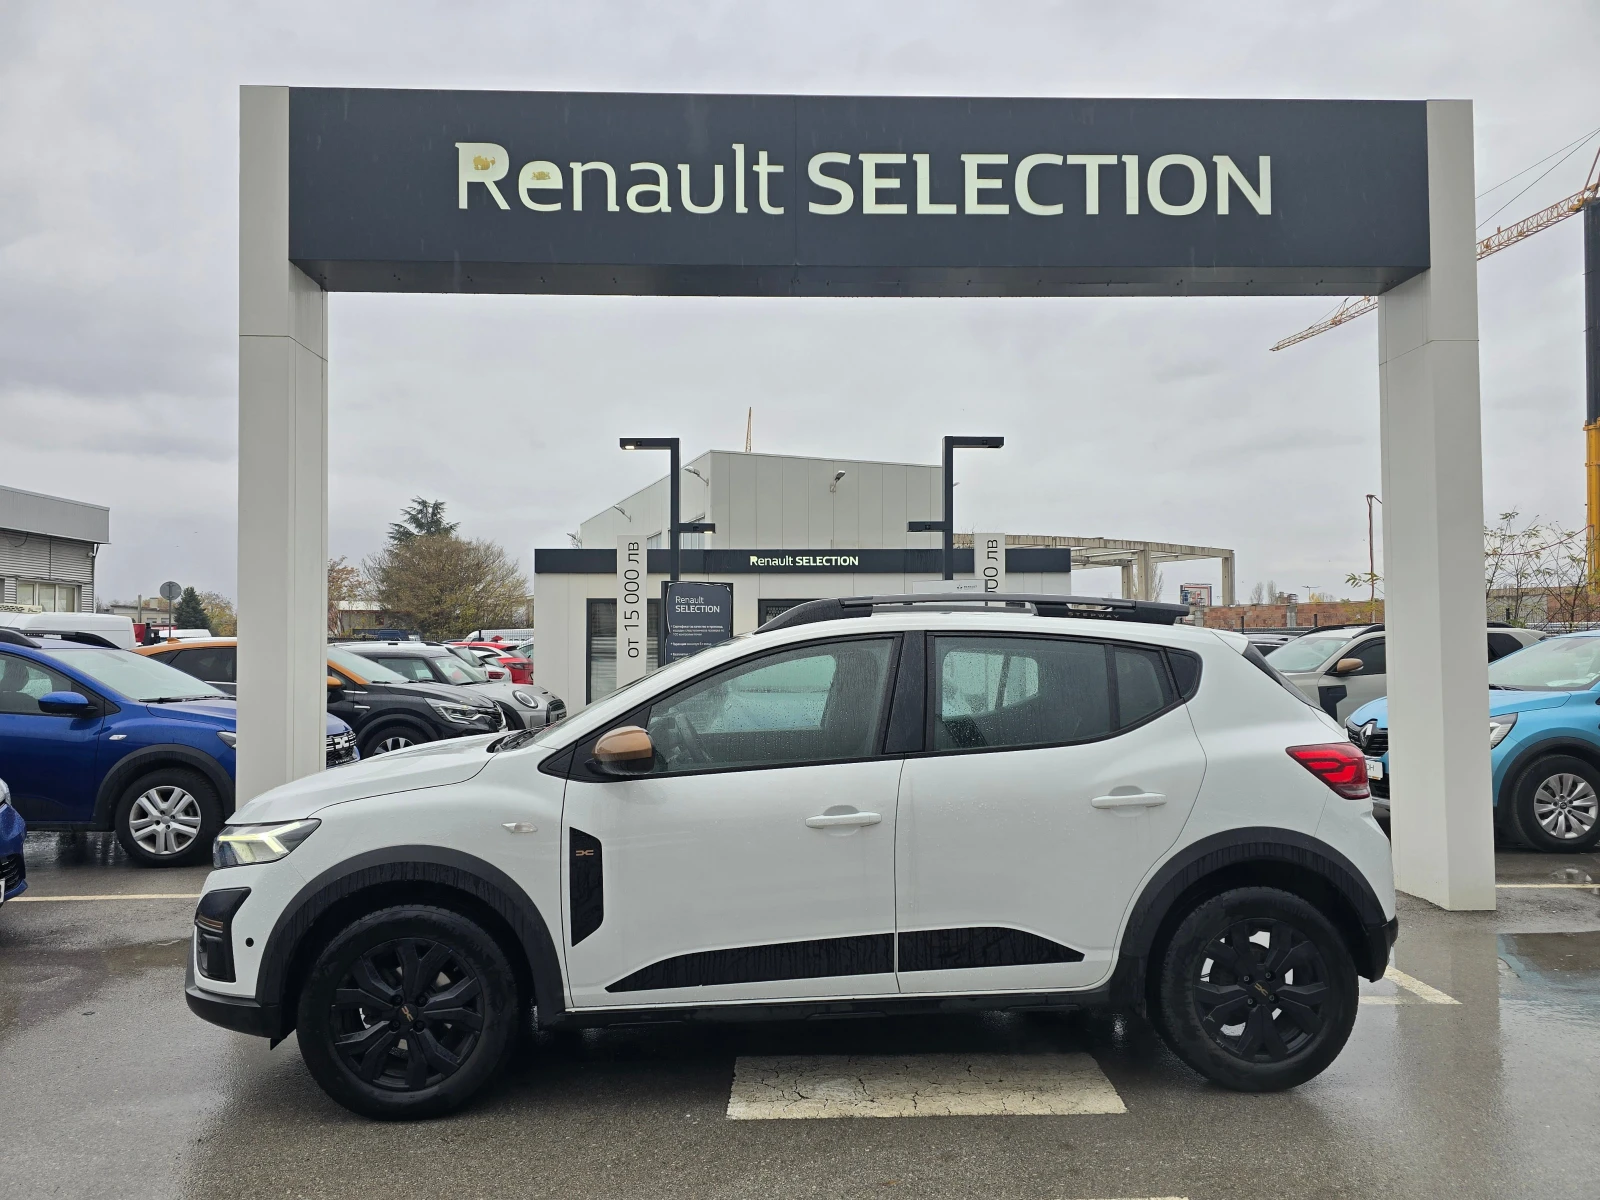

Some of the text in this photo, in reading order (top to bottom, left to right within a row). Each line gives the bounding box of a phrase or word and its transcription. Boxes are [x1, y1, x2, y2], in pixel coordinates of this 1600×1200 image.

[454, 141, 1273, 217] Renault SELECTION
[749, 555, 859, 567] Renault SELECTION
[624, 569, 640, 604] 000
[675, 595, 704, 604] Renault
[675, 605, 720, 613] SELECTION
[1067, 611, 1120, 619] STEPWAY
[624, 610, 640, 631] 15
